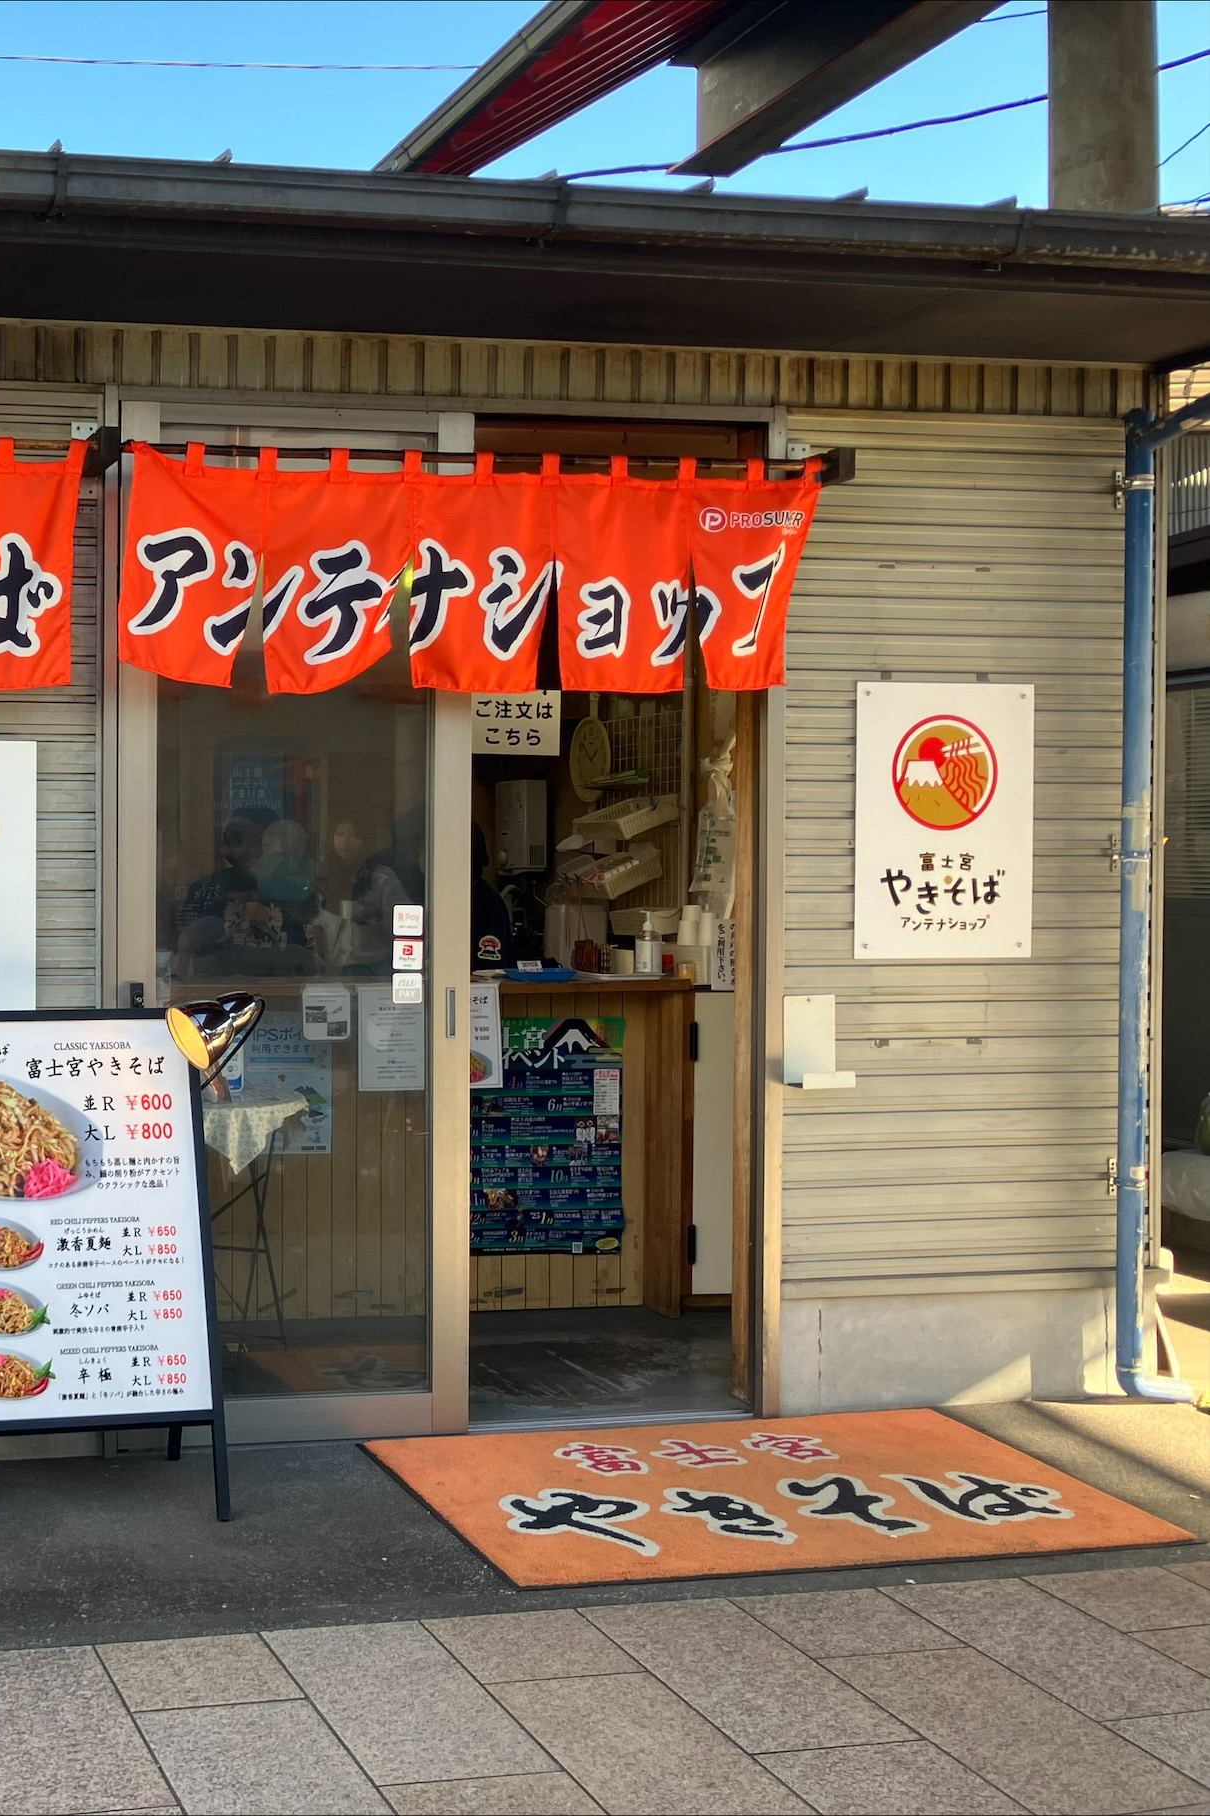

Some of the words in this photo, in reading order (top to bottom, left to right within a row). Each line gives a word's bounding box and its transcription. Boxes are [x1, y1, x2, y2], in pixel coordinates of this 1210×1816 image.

[476, 700, 553, 720] ご注文は
[485, 728, 541, 746] こちら
[919, 852, 975, 871] 富士宮
[880, 868, 1006, 915] やきそば
[900, 914, 990, 931] アンテナショップ
[399, 989, 416, 998] PAY
[53, 1042, 88, 1051] CLASSIC
[89, 1041, 131, 1050] YAKISOBA
[25, 1057, 165, 1080] 富士宮やきそば
[125, 1093, 173, 1111] ¥600
[125, 1122, 174, 1140] ¥800
[111, 1216, 140, 1224] YAKISOBA
[147, 1226, 176, 1237] ¥650
[148, 1244, 177, 1255] ¥850
[56, 1282, 77, 1290] GREEN
[124, 1279, 155, 1287] YAKISOBA
[153, 1290, 182, 1302] ¥650
[70, 1302, 109, 1318] 冬ソバ
[153, 1308, 183, 1320] ¥850
[128, 1344, 158, 1353] YAKISOBA
[157, 1355, 186, 1366] ¥650
[157, 1374, 186, 1385] ¥850
[554, 1432, 839, 1476] 富士宮
[500, 1471, 1075, 1557] やきそば
